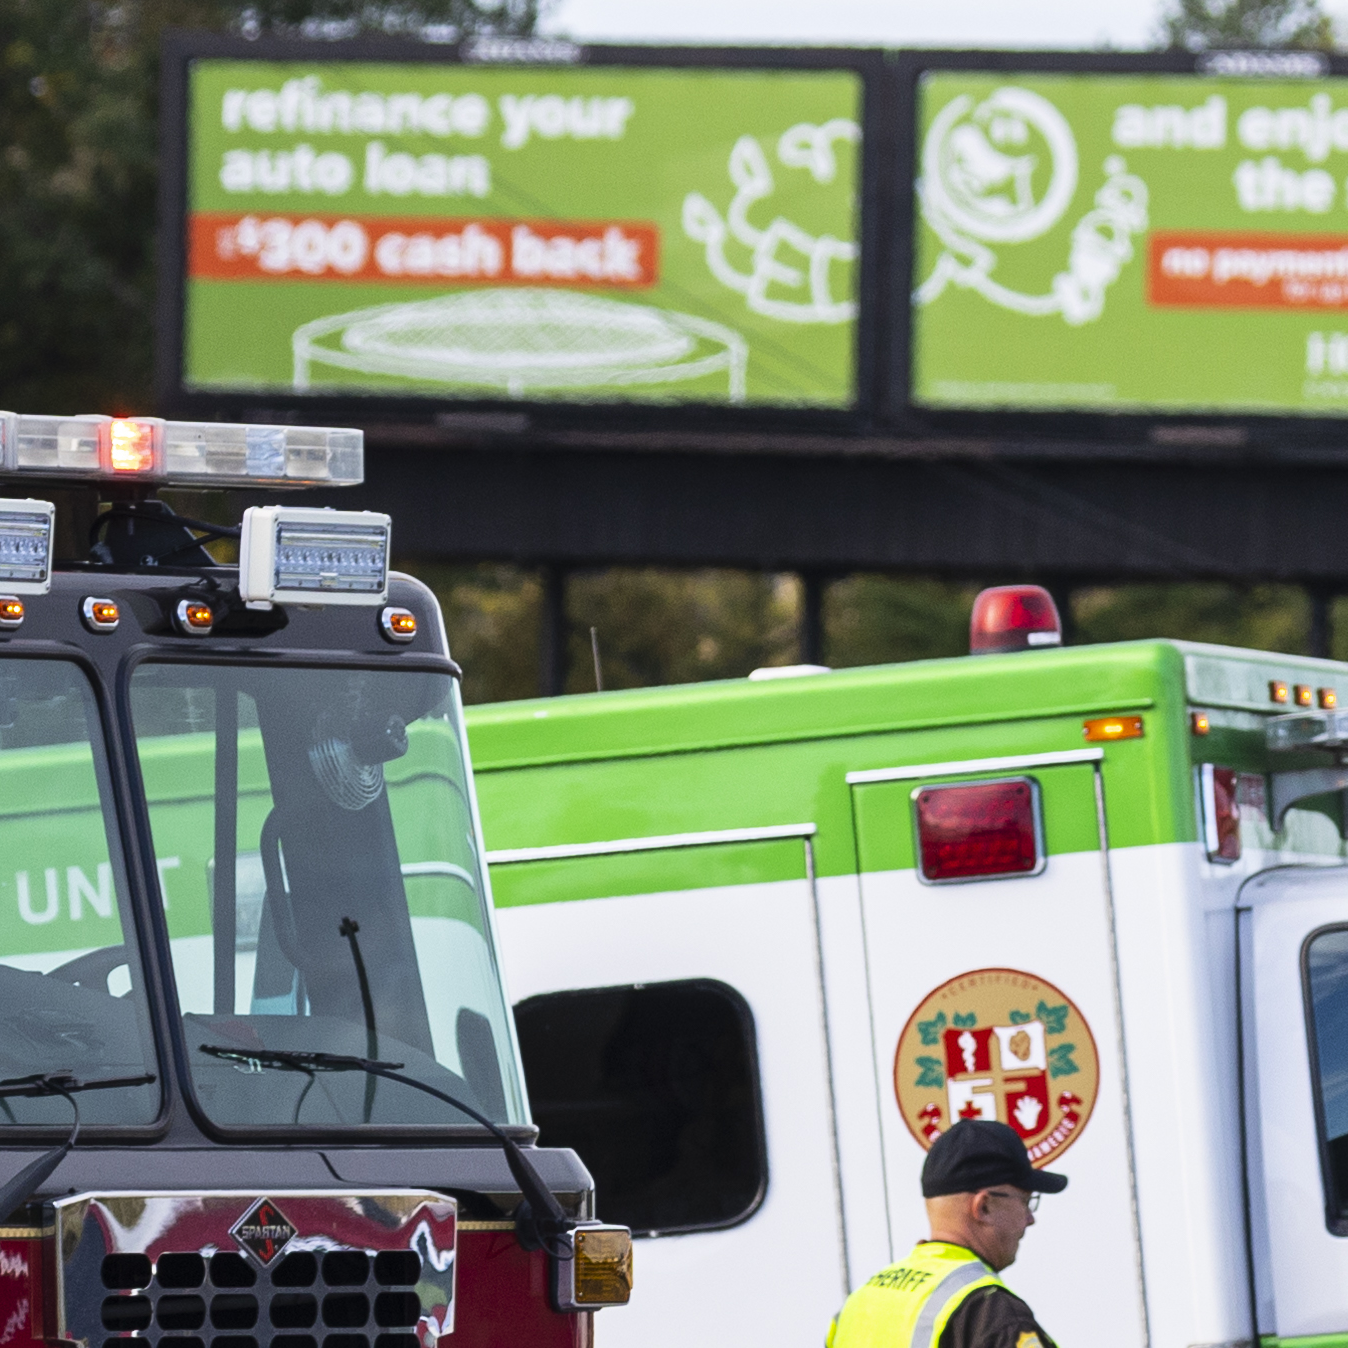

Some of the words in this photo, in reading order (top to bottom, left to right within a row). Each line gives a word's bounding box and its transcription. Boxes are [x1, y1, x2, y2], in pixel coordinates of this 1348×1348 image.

[222, 76, 489, 136] refinance
[501, 95, 634, 149] your
[1113, 95, 1227, 149] and
[219, 144, 351, 195] auto
[364, 141, 490, 198] loan
[1234, 157, 1334, 212] the
[375, 223, 503, 276] cash
[512, 225, 642, 280] back
[1162, 248, 1209, 278] no
[15, 856, 180, 925] UNT
[241, 1225, 290, 1239] SPARTAN
